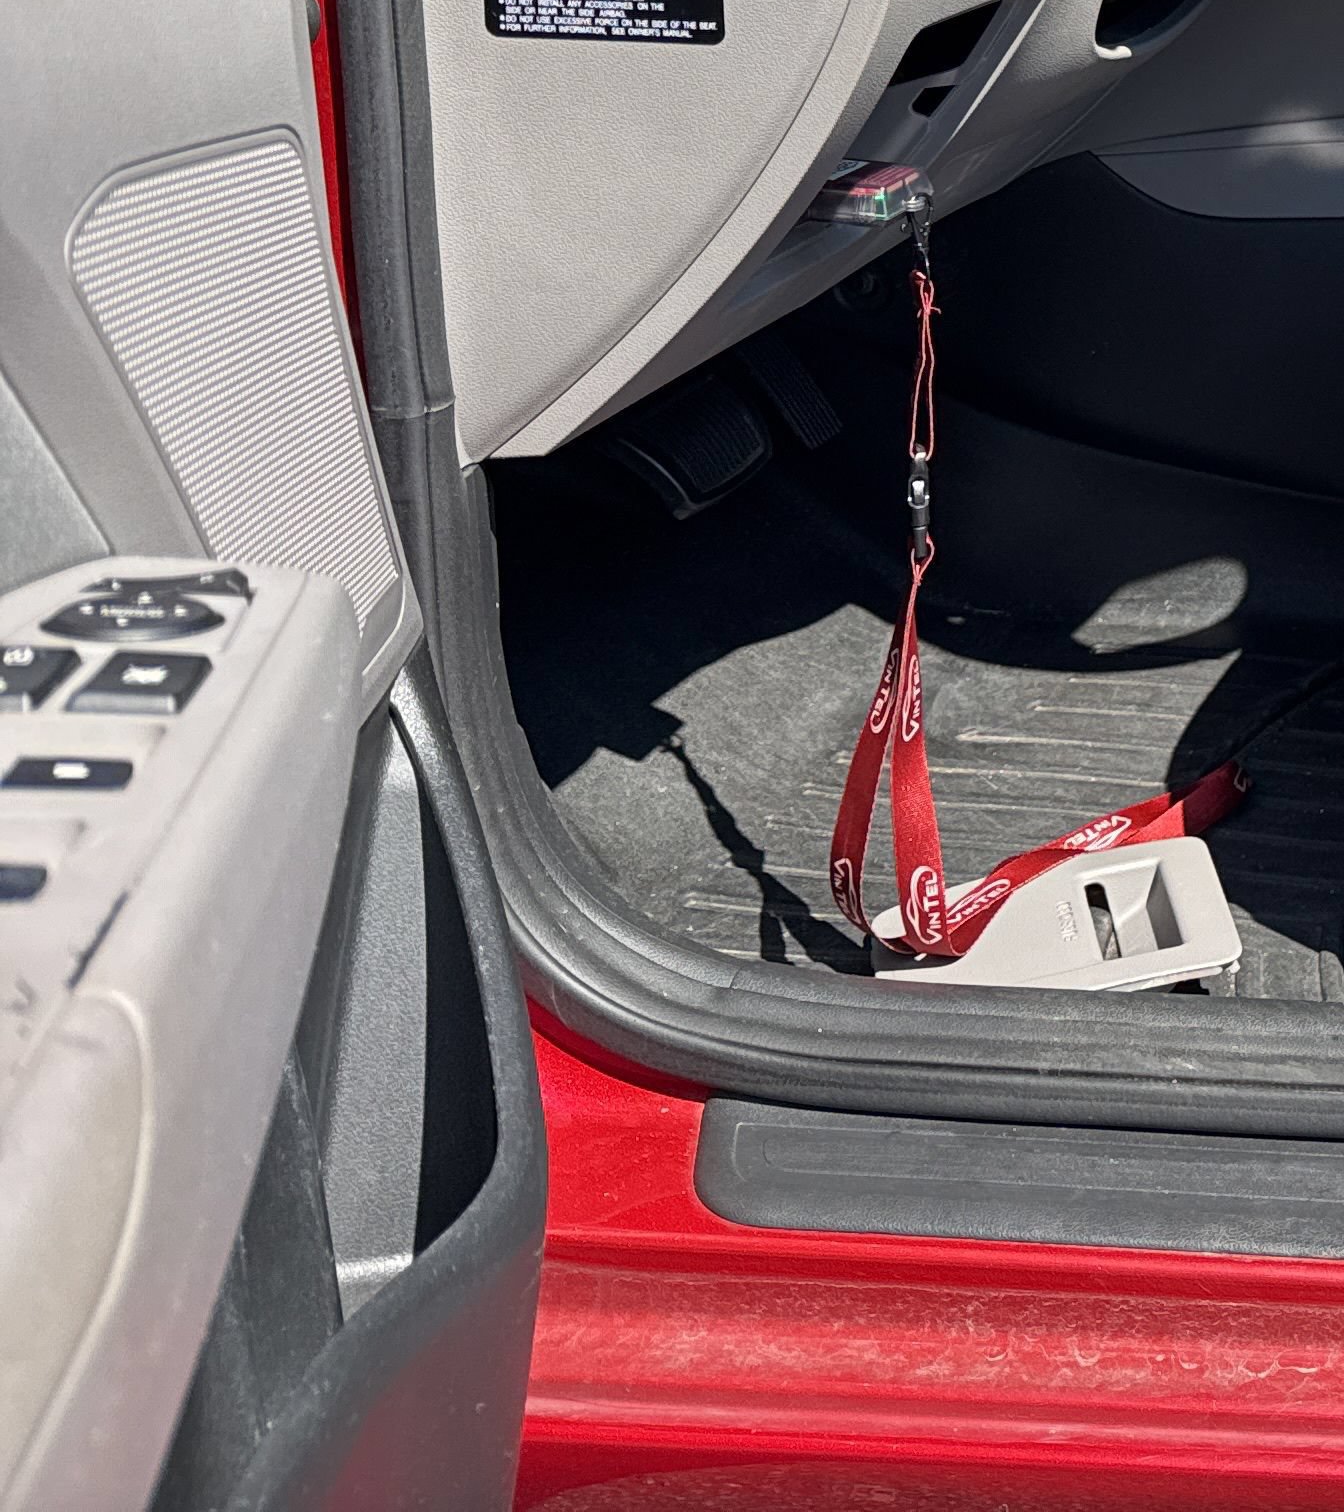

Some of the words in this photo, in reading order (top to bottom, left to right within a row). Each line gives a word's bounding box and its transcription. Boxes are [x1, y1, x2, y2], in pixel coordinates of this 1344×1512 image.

[505, 5, 520, 13] SIDE
[578, 8, 593, 16] SIDE
[567, 0, 581, 7] ANY
[637, 2, 648, 10] ON
[651, 2, 664, 11] THE
[505, 14, 515, 22] DO
[519, 15, 533, 23] NOT
[536, 15, 550, 23] USE
[594, 18, 618, 26] FORCE
[635, 19, 648, 27] THE
[670, 20, 680, 28] OF
[683, 21, 696, 29] THE
[506, 23, 520, 31] FOR
[524, 24, 555, 32] FURTHER
[611, 27, 624, 35] SEE
[907, 866, 938, 945] VINTEL
